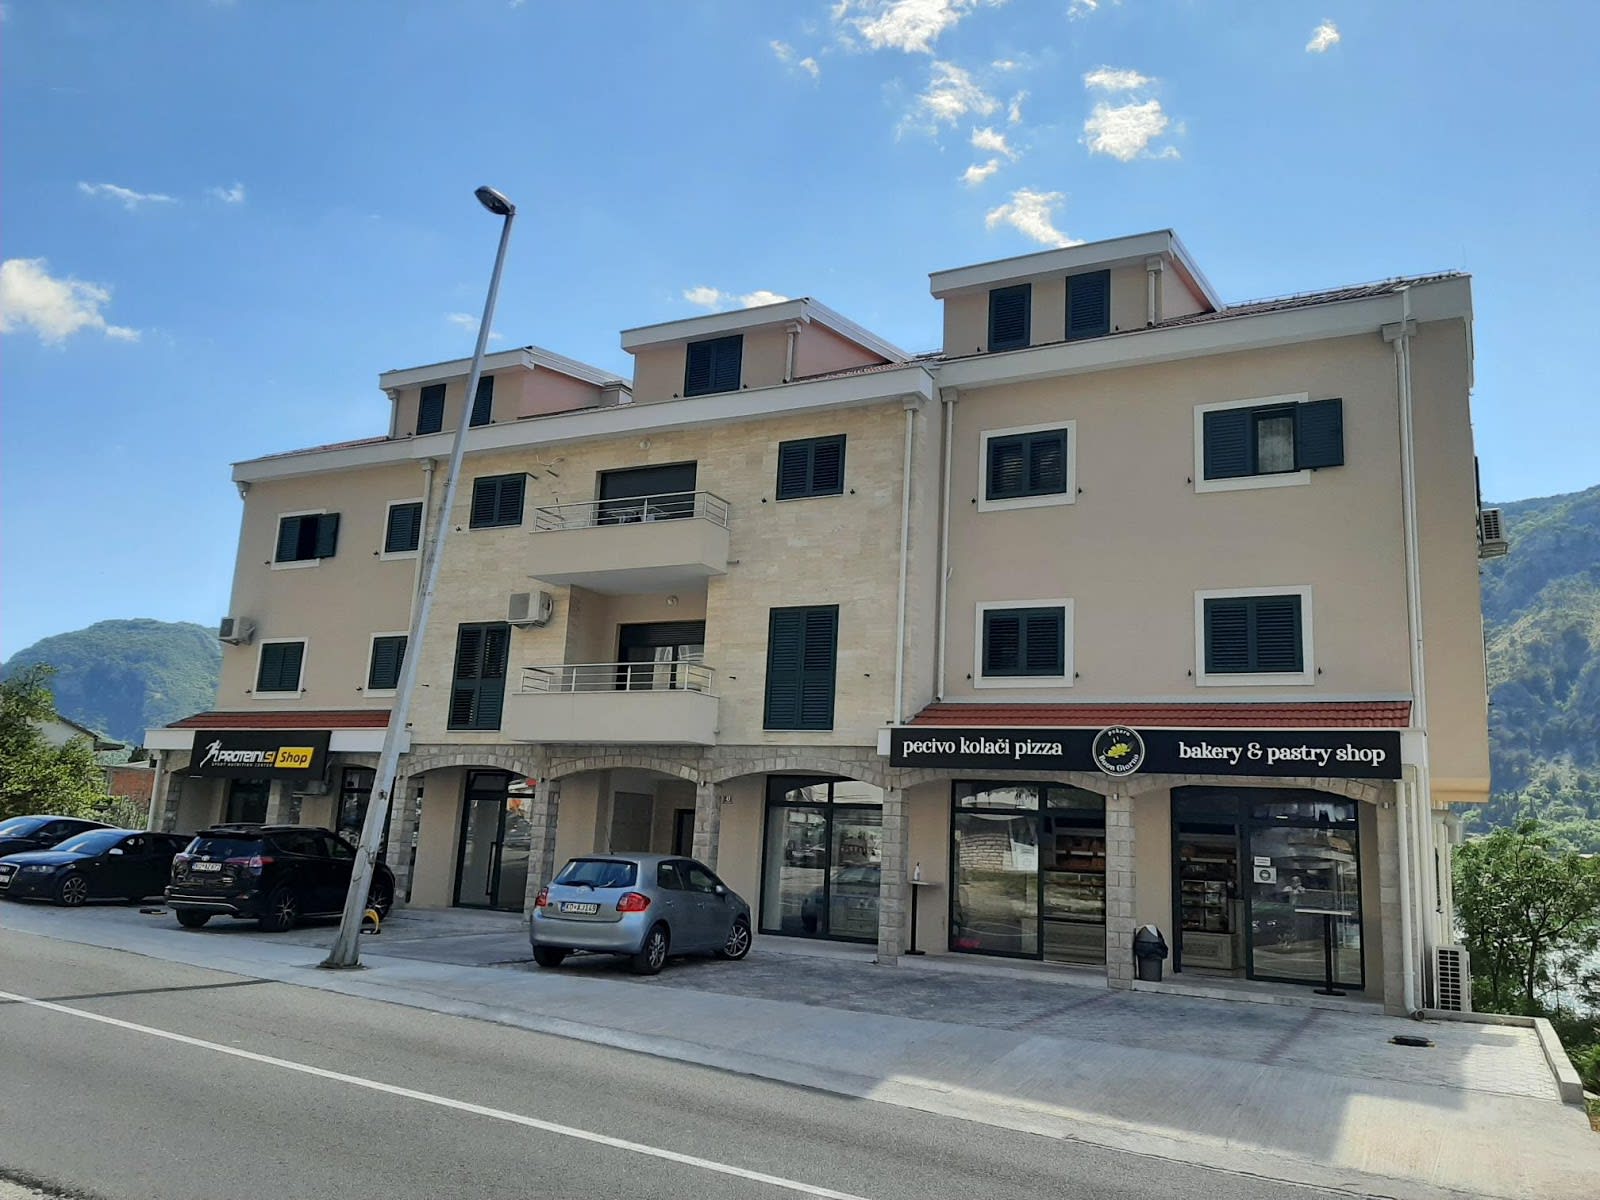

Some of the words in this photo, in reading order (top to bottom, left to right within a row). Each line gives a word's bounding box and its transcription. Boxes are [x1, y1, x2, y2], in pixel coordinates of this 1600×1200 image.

[280, 752, 308, 765] Shop
[902, 738, 956, 757] pecivo
[959, 737, 1010, 755] kolači
[1014, 739, 1063, 760] pizza
[1178, 742, 1243, 765] bakery
[1247, 742, 1262, 760] &
[1267, 744, 1332, 766] pastry
[1336, 744, 1386, 766] shop
